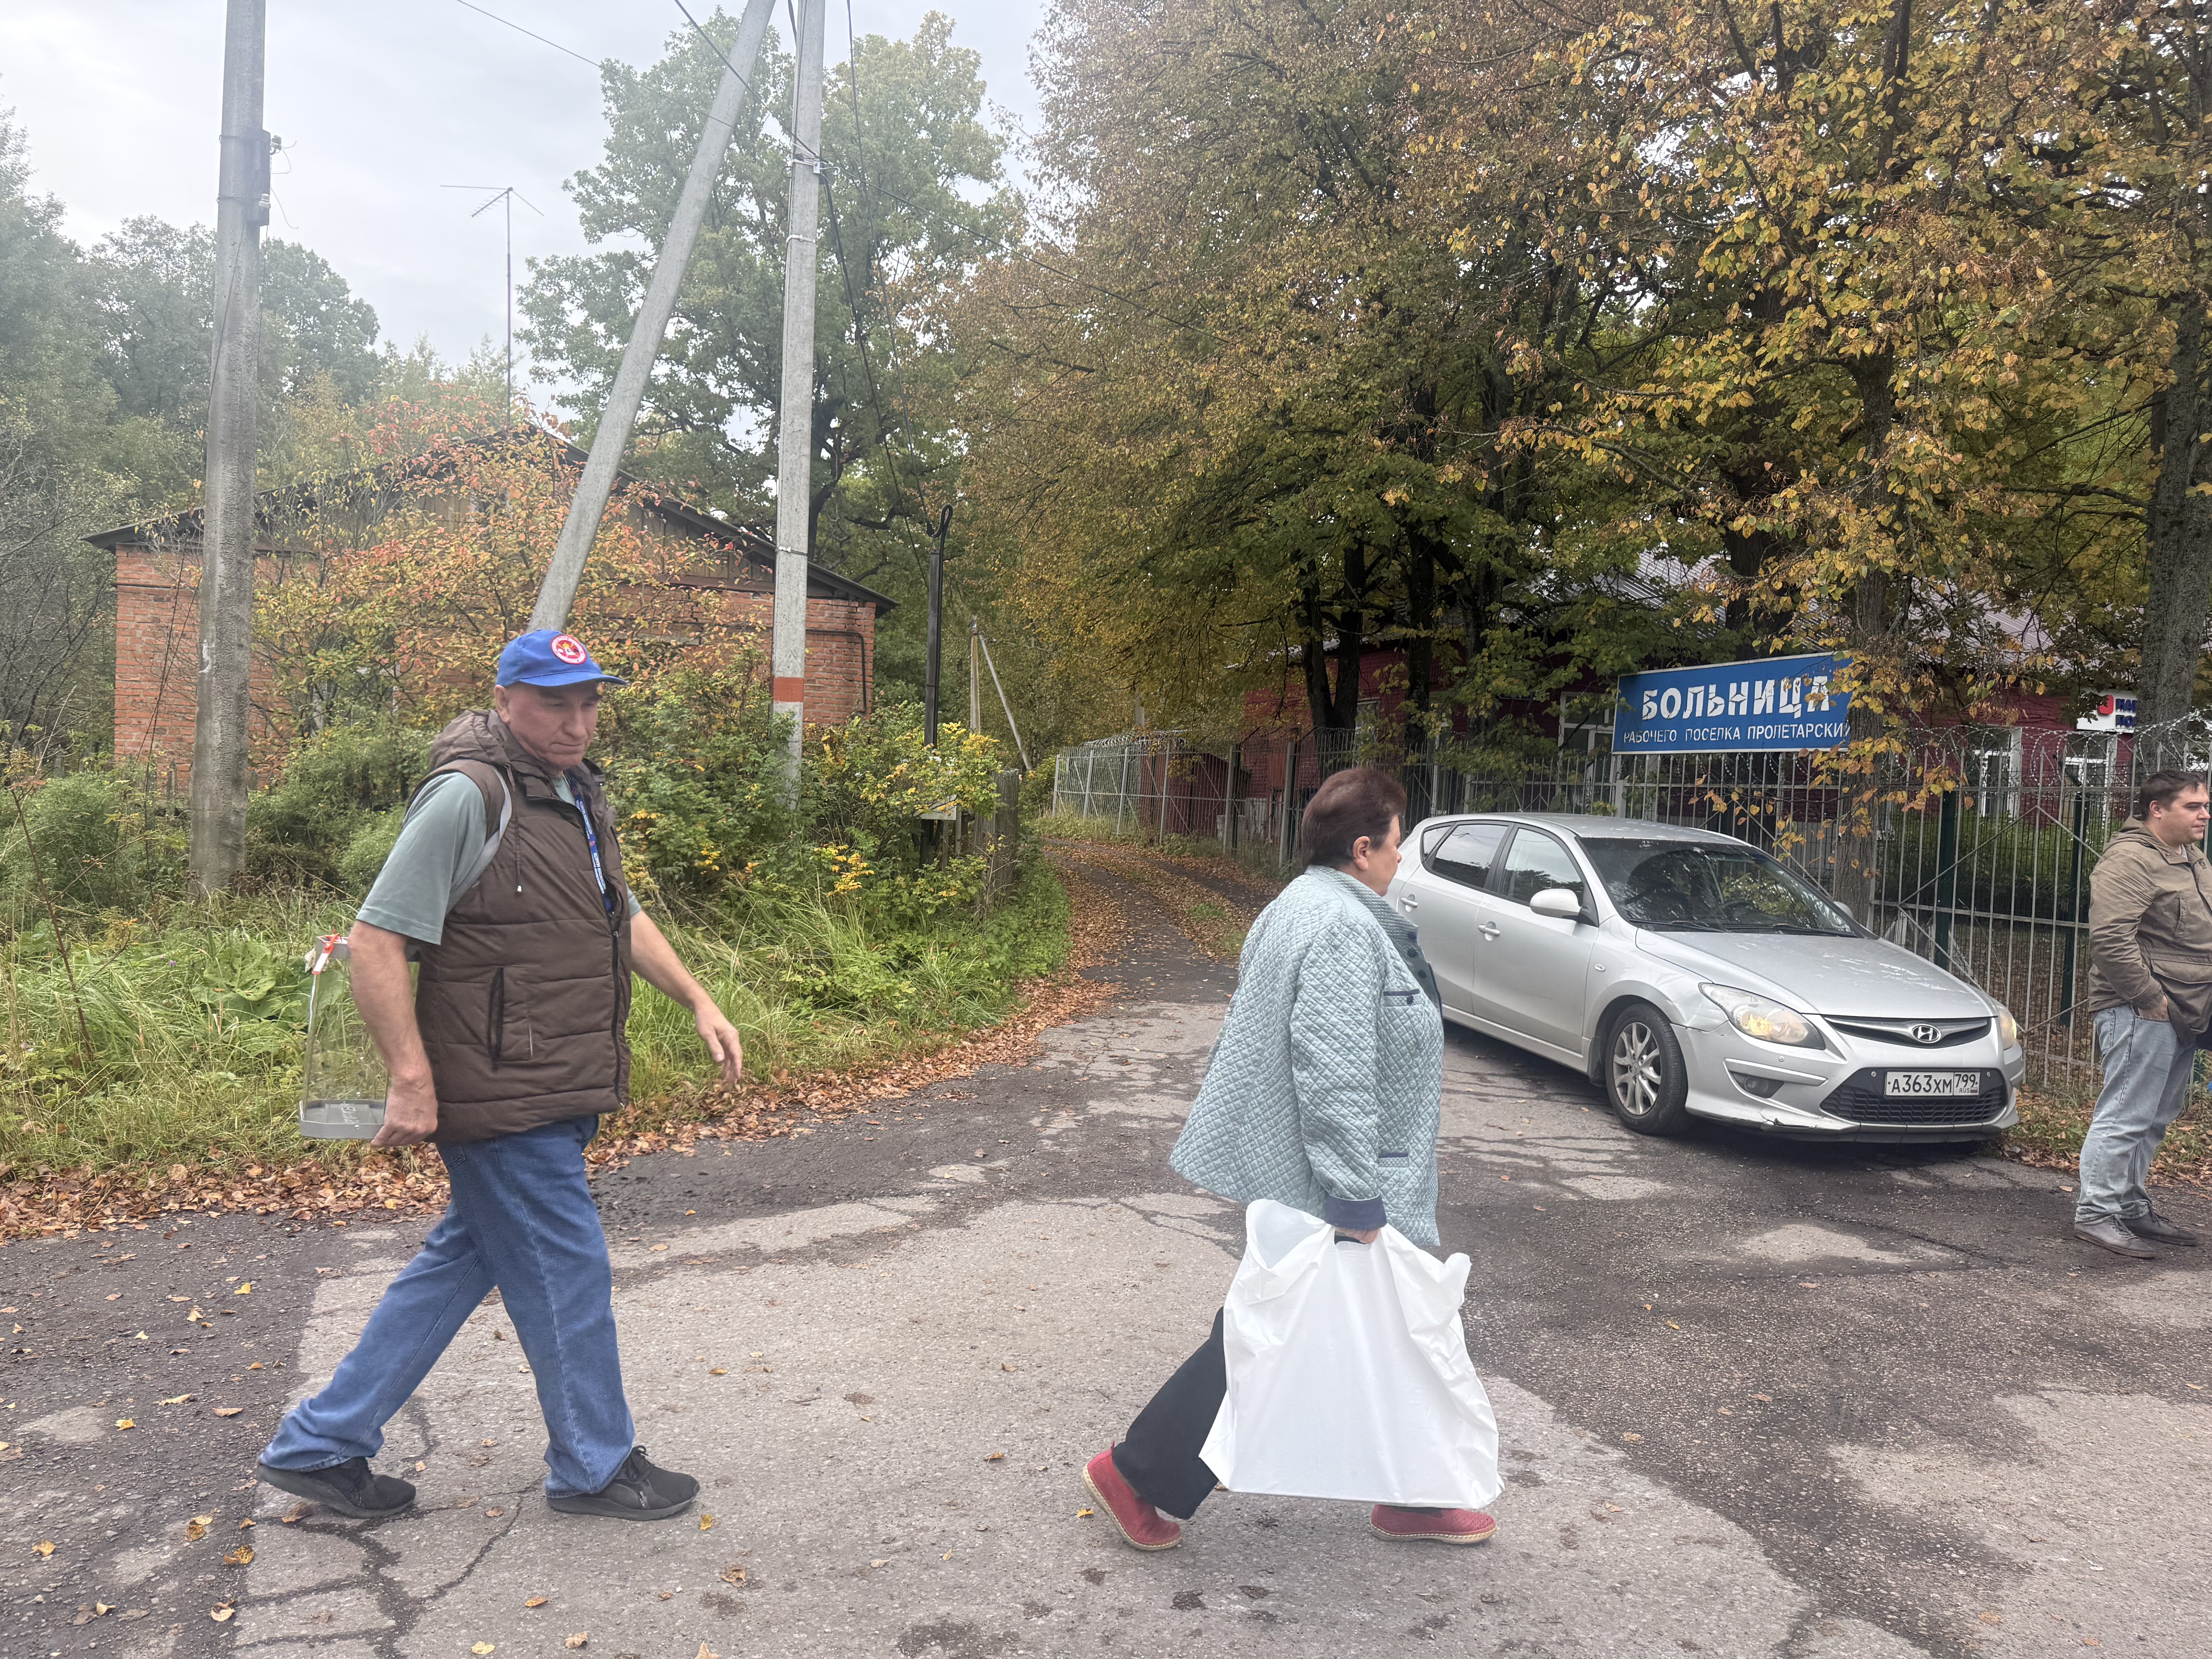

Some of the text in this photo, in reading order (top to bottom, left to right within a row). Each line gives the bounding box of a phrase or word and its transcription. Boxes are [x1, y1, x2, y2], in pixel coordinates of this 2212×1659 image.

[1642, 676, 1829, 720] БОЛЬНИЦА
[1624, 730, 1677, 743] РАБОЧЕГО
[1685, 726, 1740, 741] ПОСЕЛКА
[1955, 1074, 1976, 1088] 799
